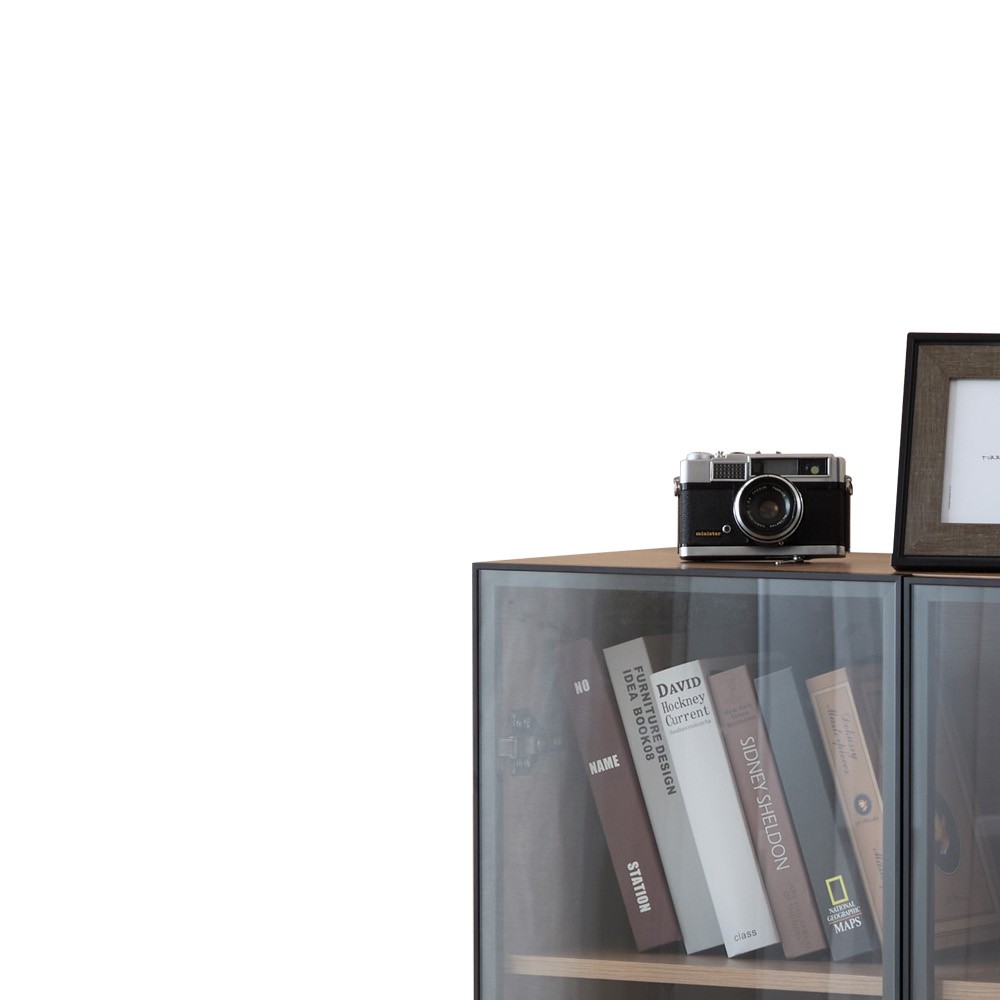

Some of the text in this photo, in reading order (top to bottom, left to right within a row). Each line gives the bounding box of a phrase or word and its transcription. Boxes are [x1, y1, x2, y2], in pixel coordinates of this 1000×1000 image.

[574, 678, 591, 695] NO
[661, 692, 705, 714] Hockney
[622, 668, 655, 762] IDEA BOOK08
[665, 705, 711, 727] Current
[634, 665, 677, 796] FURNITURE DESIGN
[588, 754, 621, 775] NAME
[740, 736, 768, 792] SIDNEY
[756, 793, 791, 872] SHELDON
[627, 860, 652, 914] STATION
[826, 905, 861, 922] GEOGRAPHIC
[828, 900, 856, 915] NATIONAL
[733, 929, 758, 942] class
[833, 916, 862, 934] MAPS
